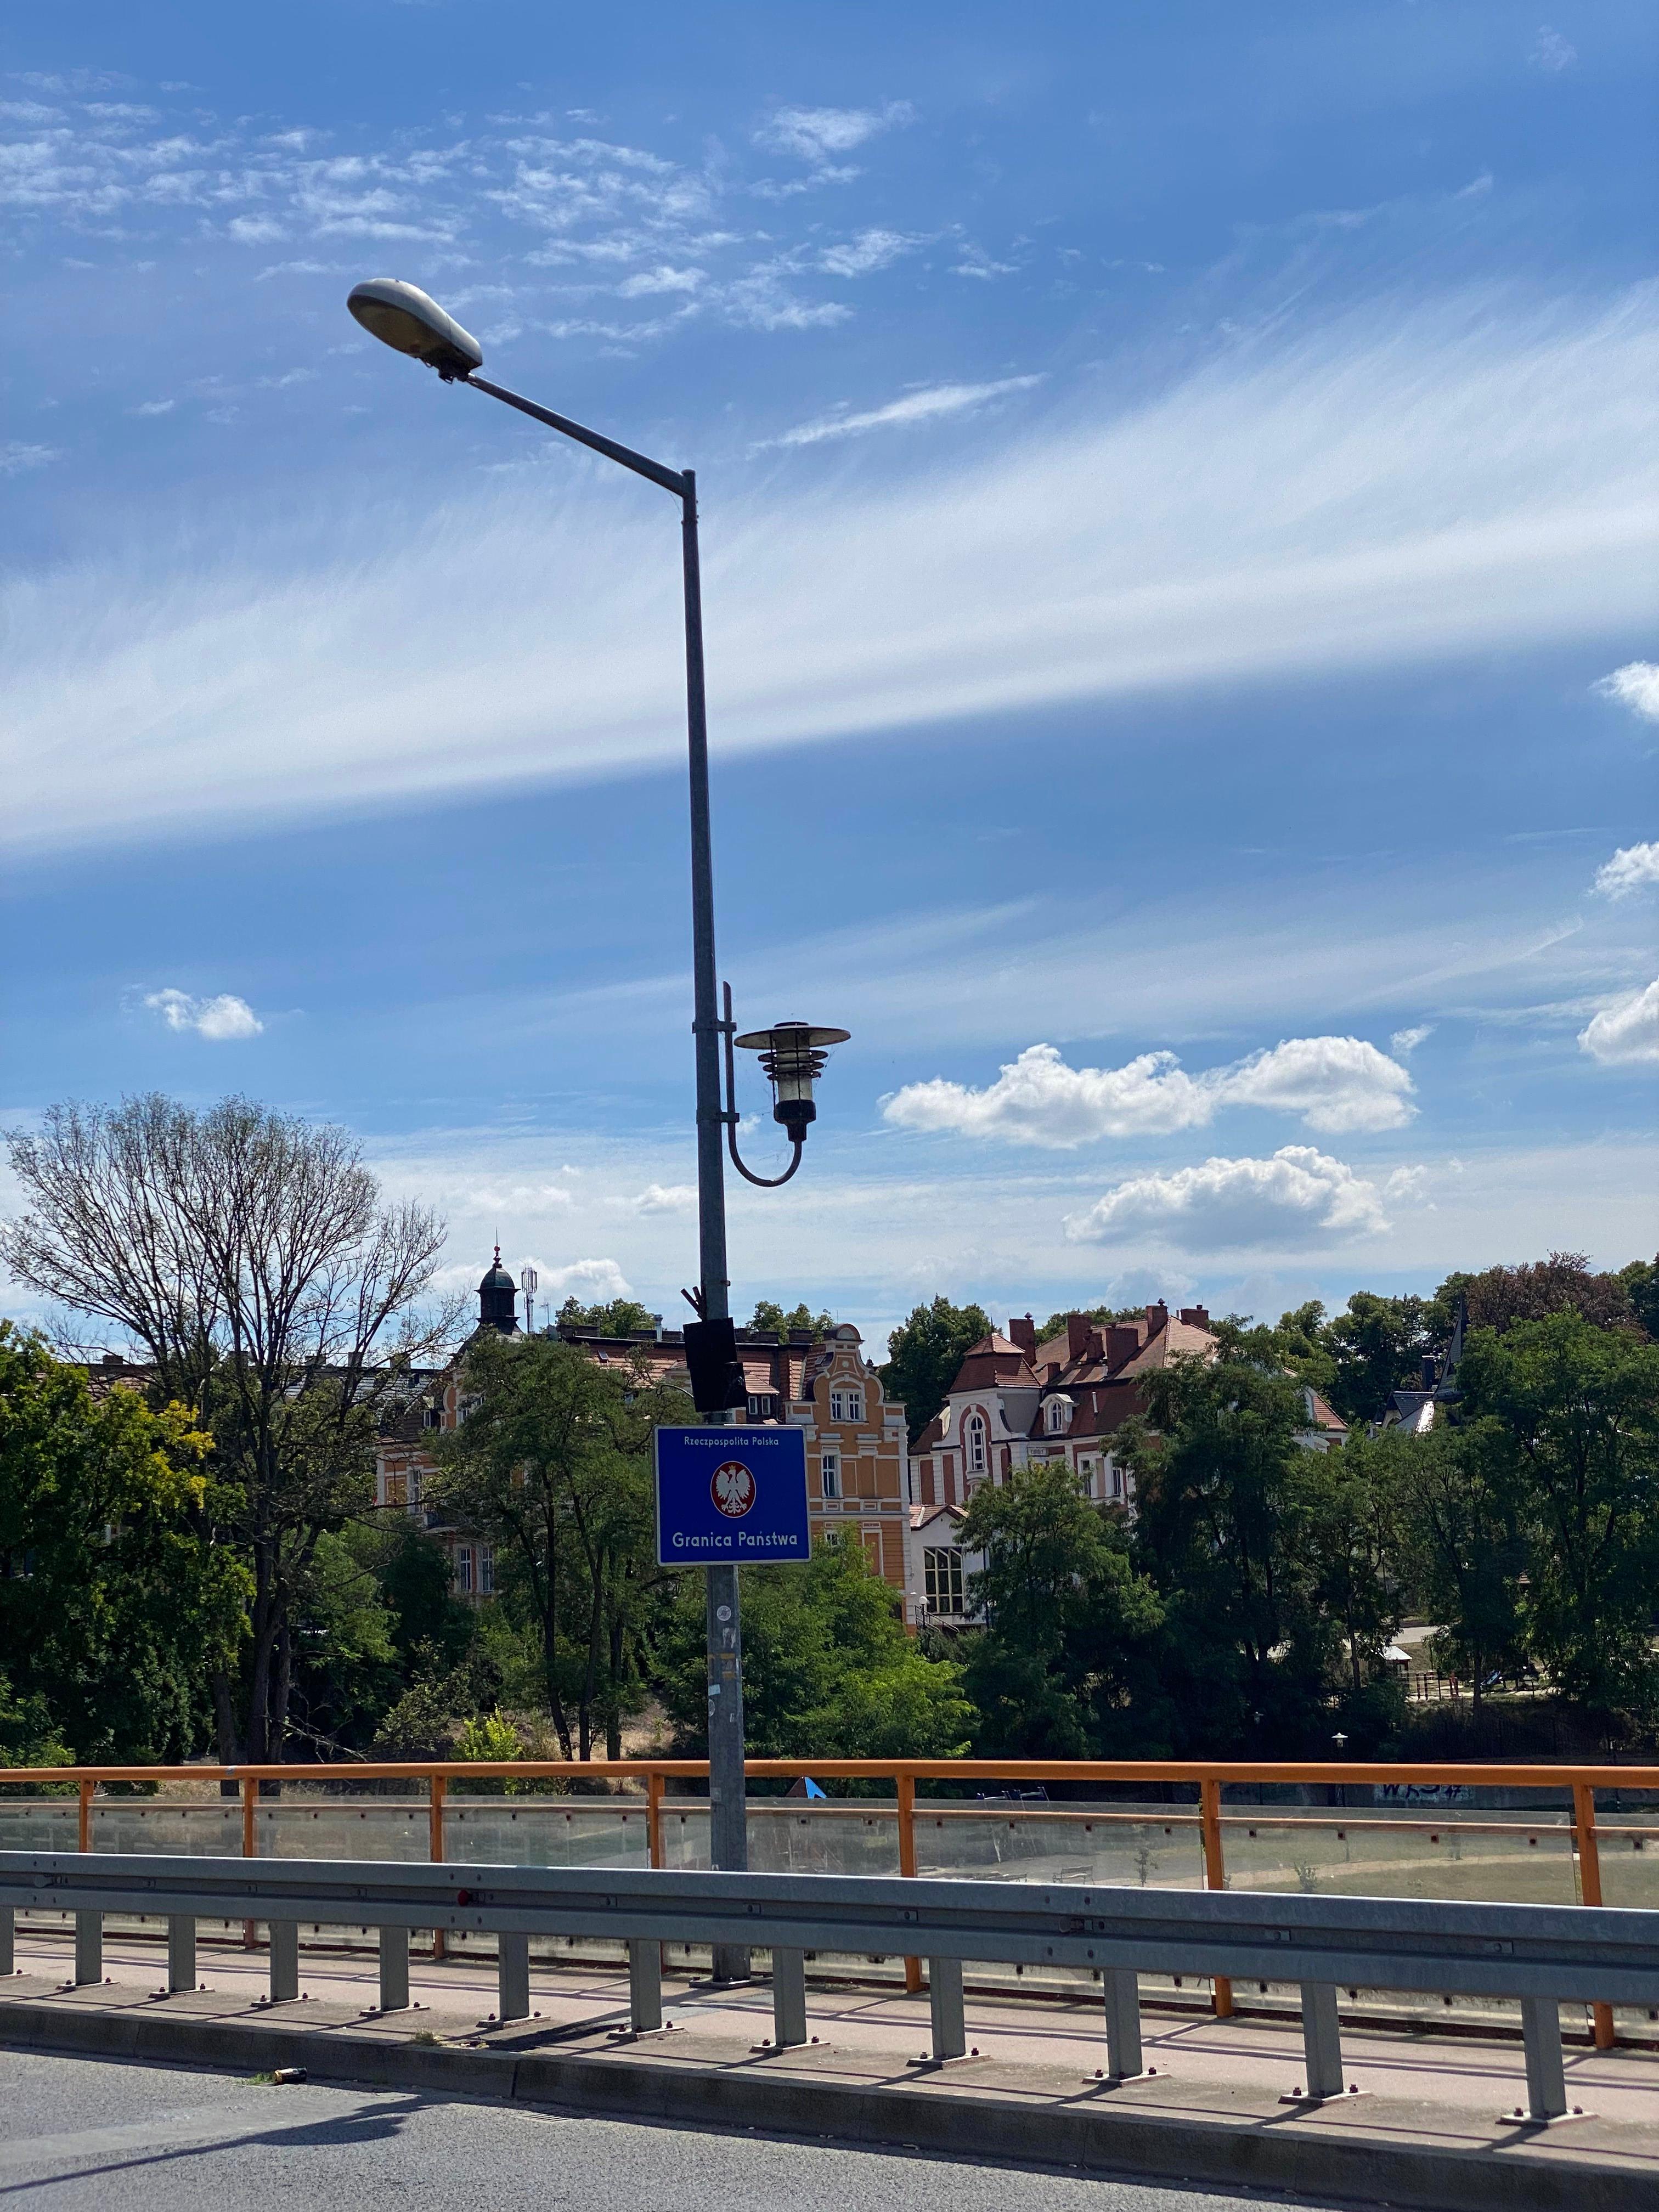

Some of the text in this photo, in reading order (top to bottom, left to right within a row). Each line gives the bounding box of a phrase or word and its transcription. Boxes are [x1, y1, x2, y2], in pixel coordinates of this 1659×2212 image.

[684, 1436, 779, 1448] Rzeczpospolita Polska
[673, 1531, 798, 1548] Granica Państwa
